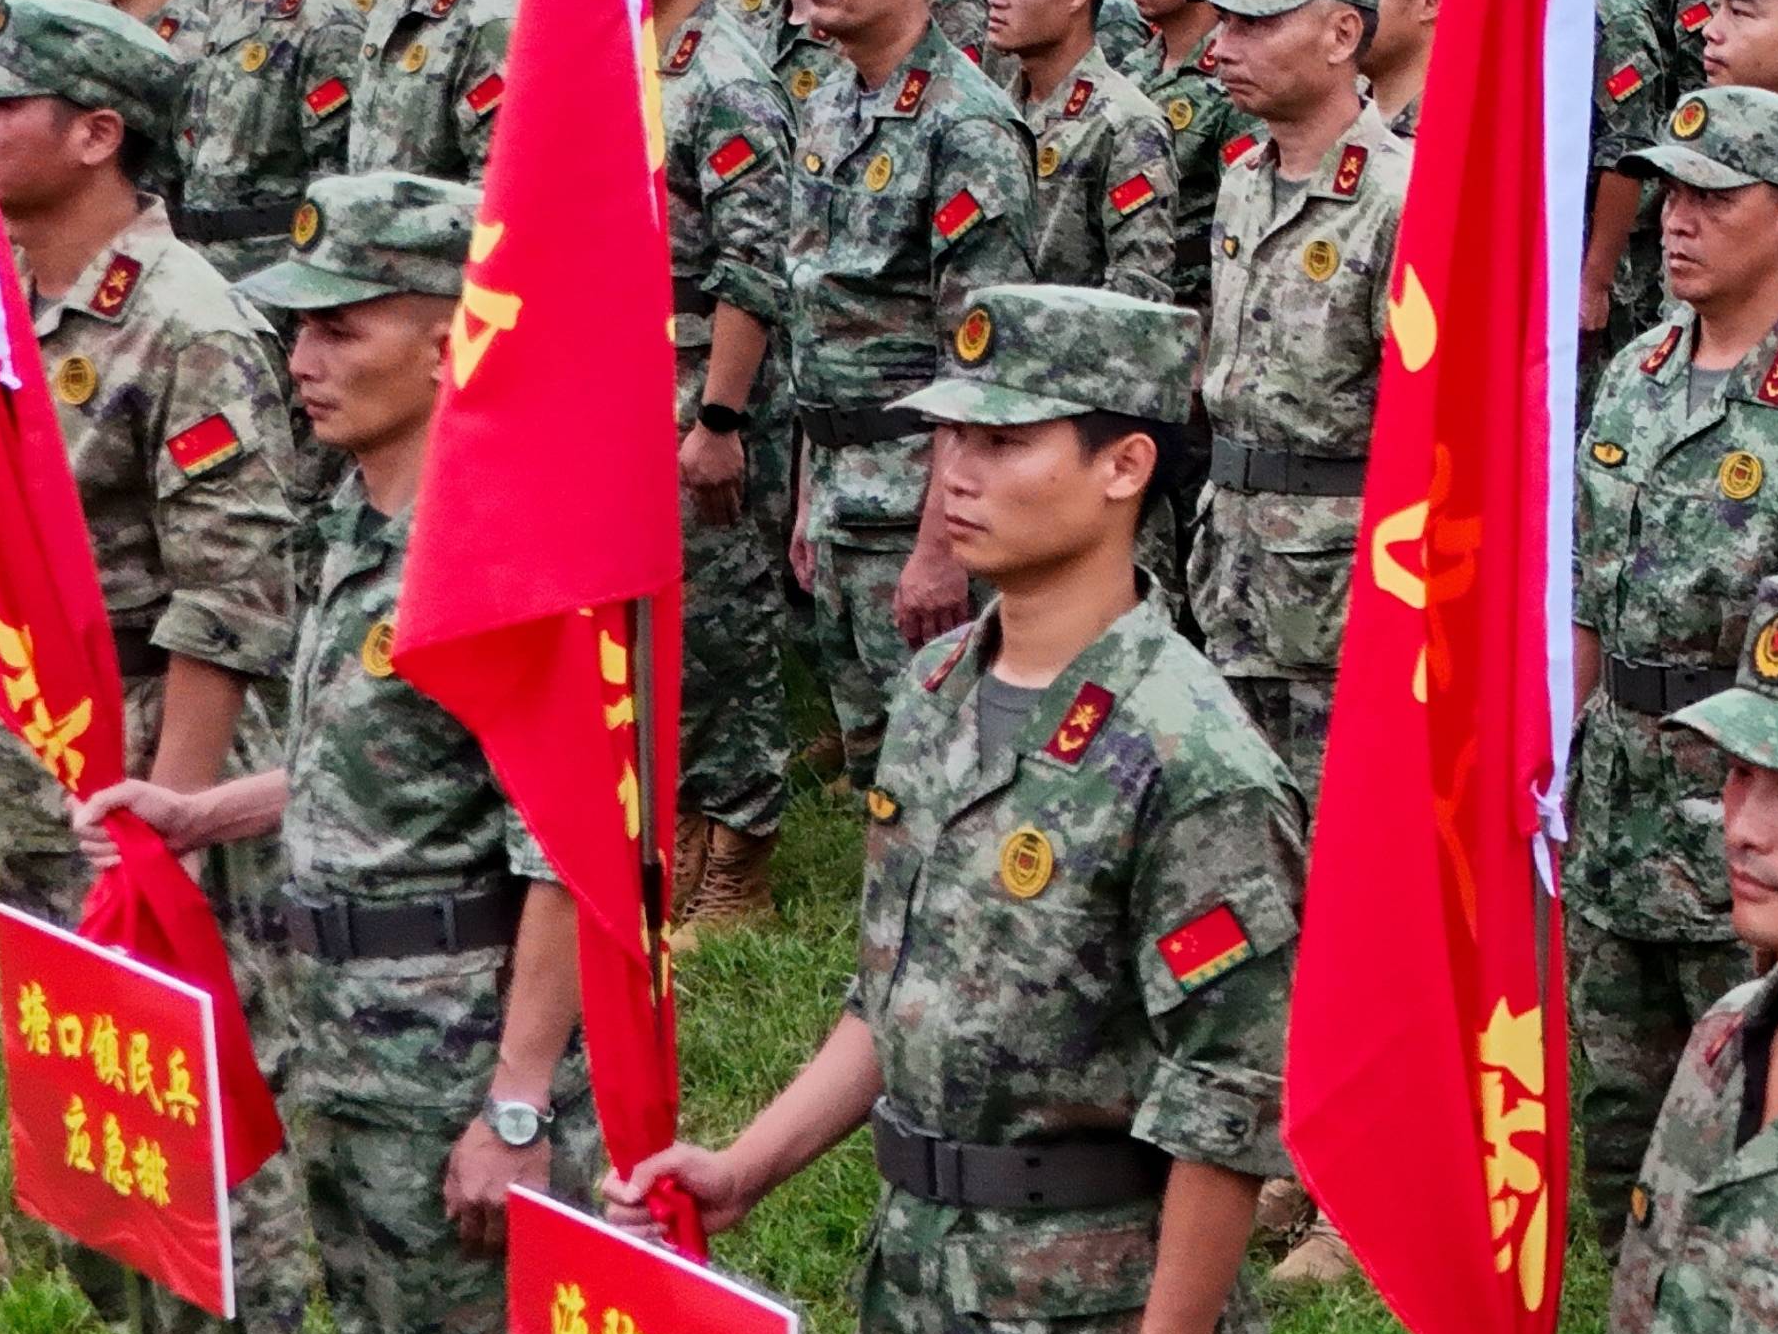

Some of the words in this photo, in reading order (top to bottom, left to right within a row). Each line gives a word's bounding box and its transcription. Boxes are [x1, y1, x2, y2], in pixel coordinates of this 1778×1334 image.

[18, 979, 201, 1127] 塘口镇民兵
[63, 1093, 171, 1207] 应急排
